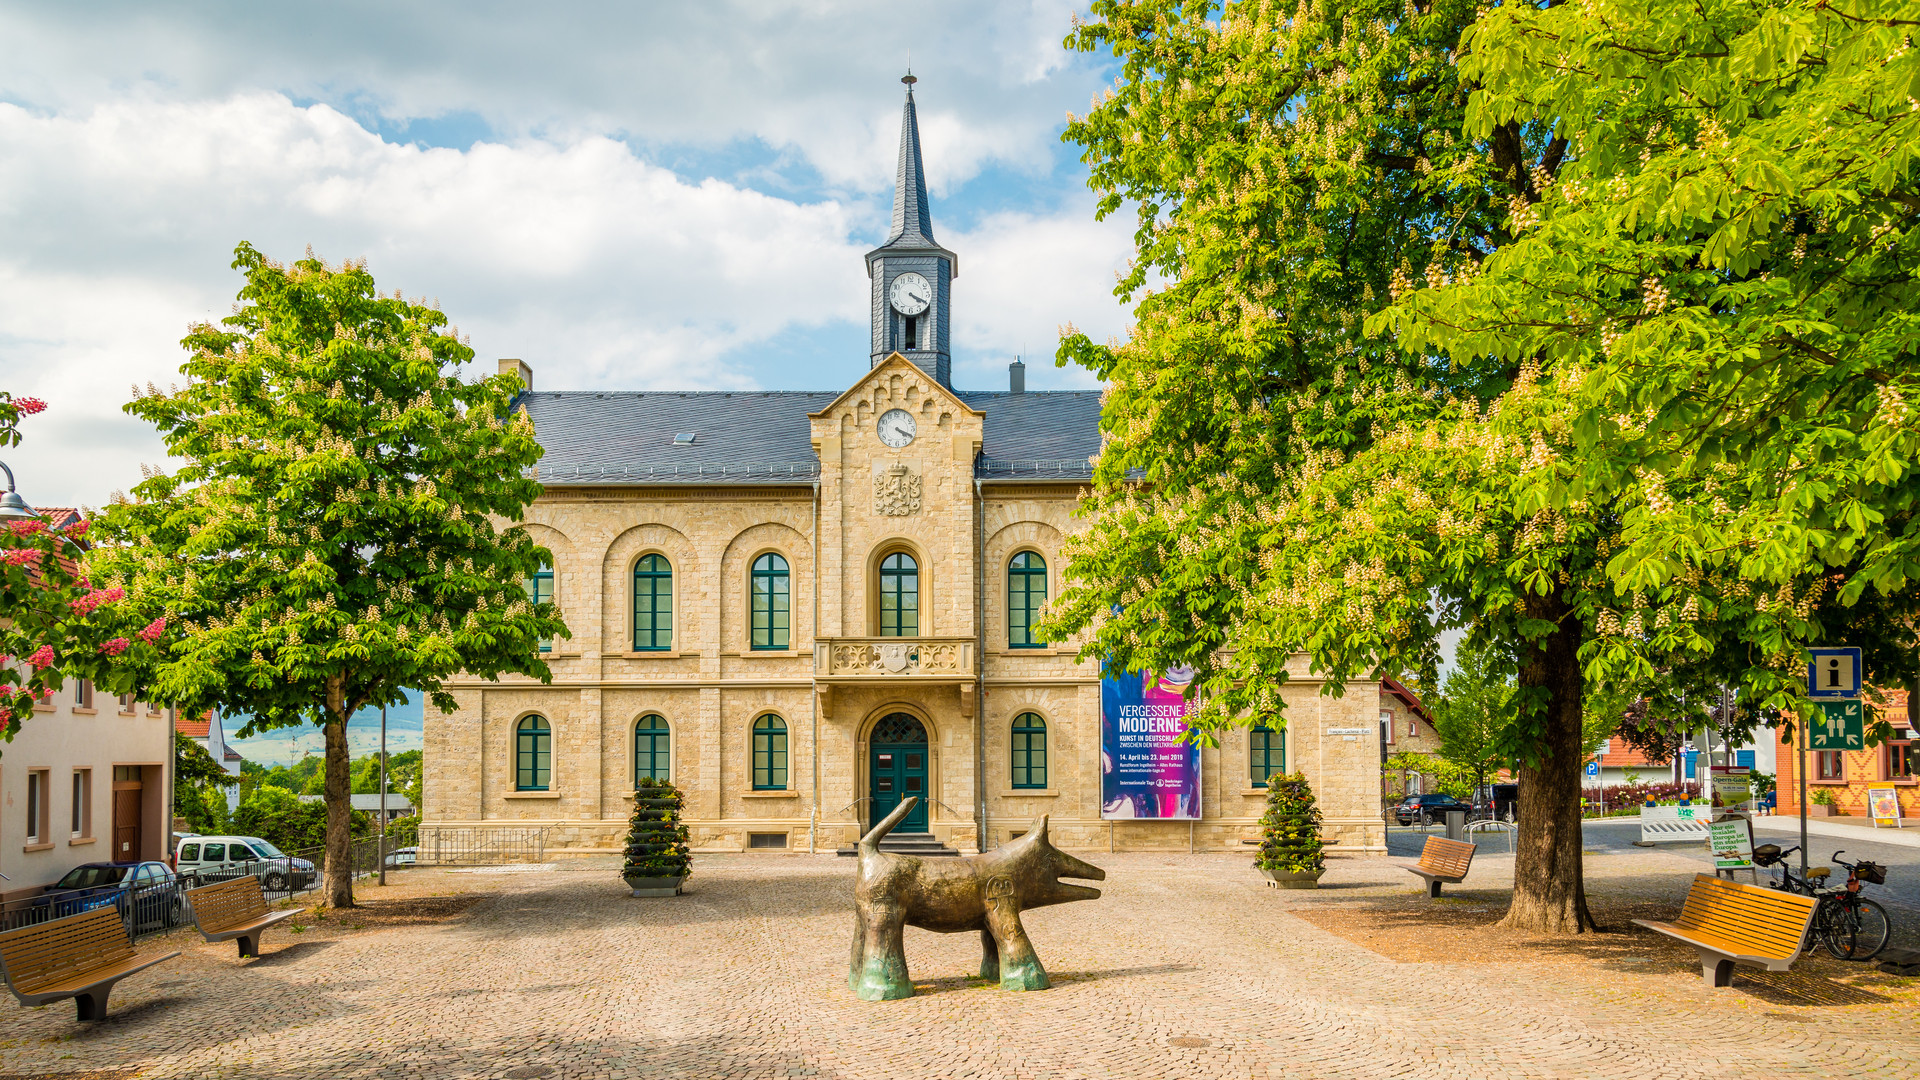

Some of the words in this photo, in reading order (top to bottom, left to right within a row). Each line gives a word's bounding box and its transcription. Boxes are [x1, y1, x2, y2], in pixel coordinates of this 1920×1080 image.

[1826, 659, 1843, 687] i
[1120, 704, 1183, 716] VERGESSENE
[1120, 717, 1183, 732] MODERNE
[1588, 764, 1595, 774] P
